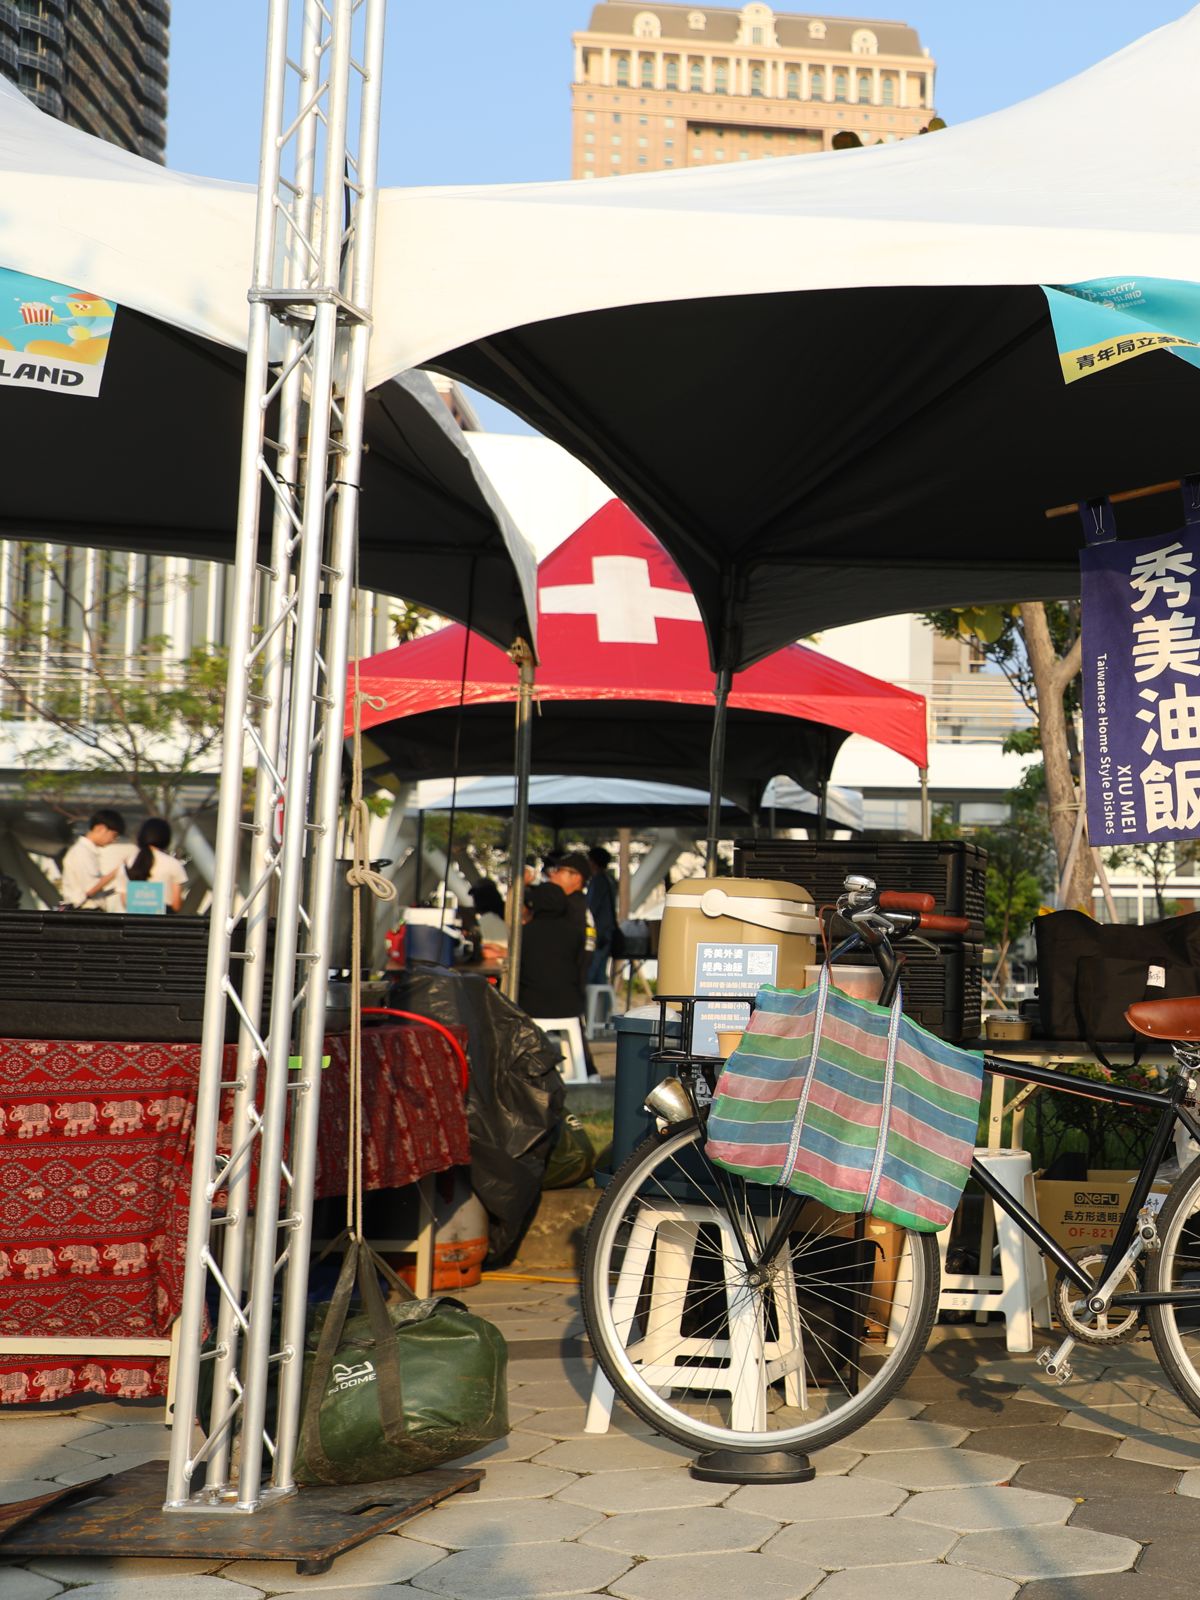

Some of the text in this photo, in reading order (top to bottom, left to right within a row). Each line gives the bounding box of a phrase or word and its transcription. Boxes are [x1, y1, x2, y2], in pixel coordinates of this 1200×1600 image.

[1097, 653, 1116, 835] Taiwanese Home Style Dishes
[1117, 765, 1137, 834] XIU MEI
[1068, 1227, 1115, 1239] OF-821
[340, 1373, 377, 1390] DOME
